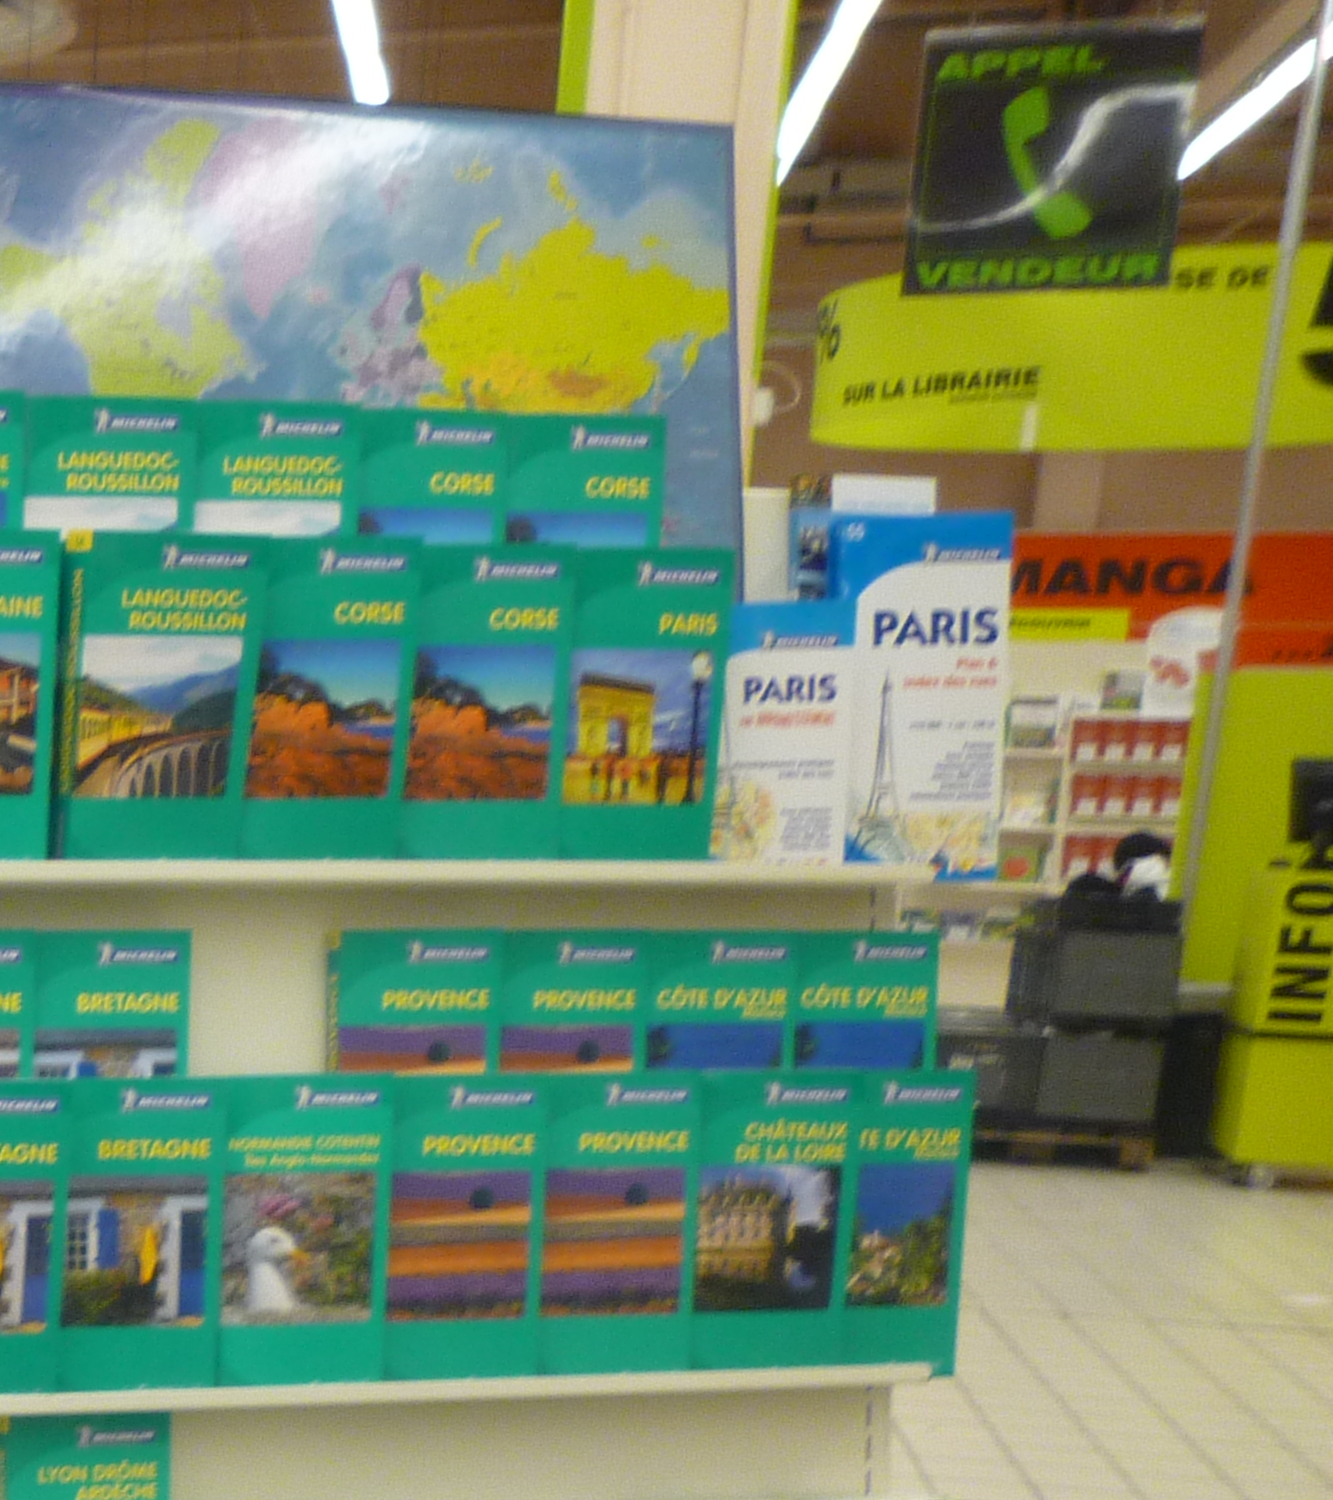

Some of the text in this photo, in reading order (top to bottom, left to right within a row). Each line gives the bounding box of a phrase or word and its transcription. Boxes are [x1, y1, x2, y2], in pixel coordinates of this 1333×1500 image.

[935, 45, 1106, 82] APPEL
[916, 253, 1160, 289] VENDEUR
[844, 365, 1040, 406] SUR LA LIBRAIRIE
[232, 477, 342, 495] ROUSSILLON
[430, 472, 494, 494] CORSE
[586, 477, 649, 498] CORSE
[651, 567, 720, 585] MICHELIN
[130, 611, 246, 630] ROUSSILLON
[335, 602, 404, 623] CORSE
[660, 613, 718, 635] PARIS
[873, 607, 999, 647] PARIS
[743, 673, 838, 705] PARIS
[77, 993, 178, 1012] BRETAGNE
[382, 989, 490, 1011] PROVENCE
[533, 988, 635, 1010] PROVENCE
[423, 1133, 536, 1156] PROVENCE
